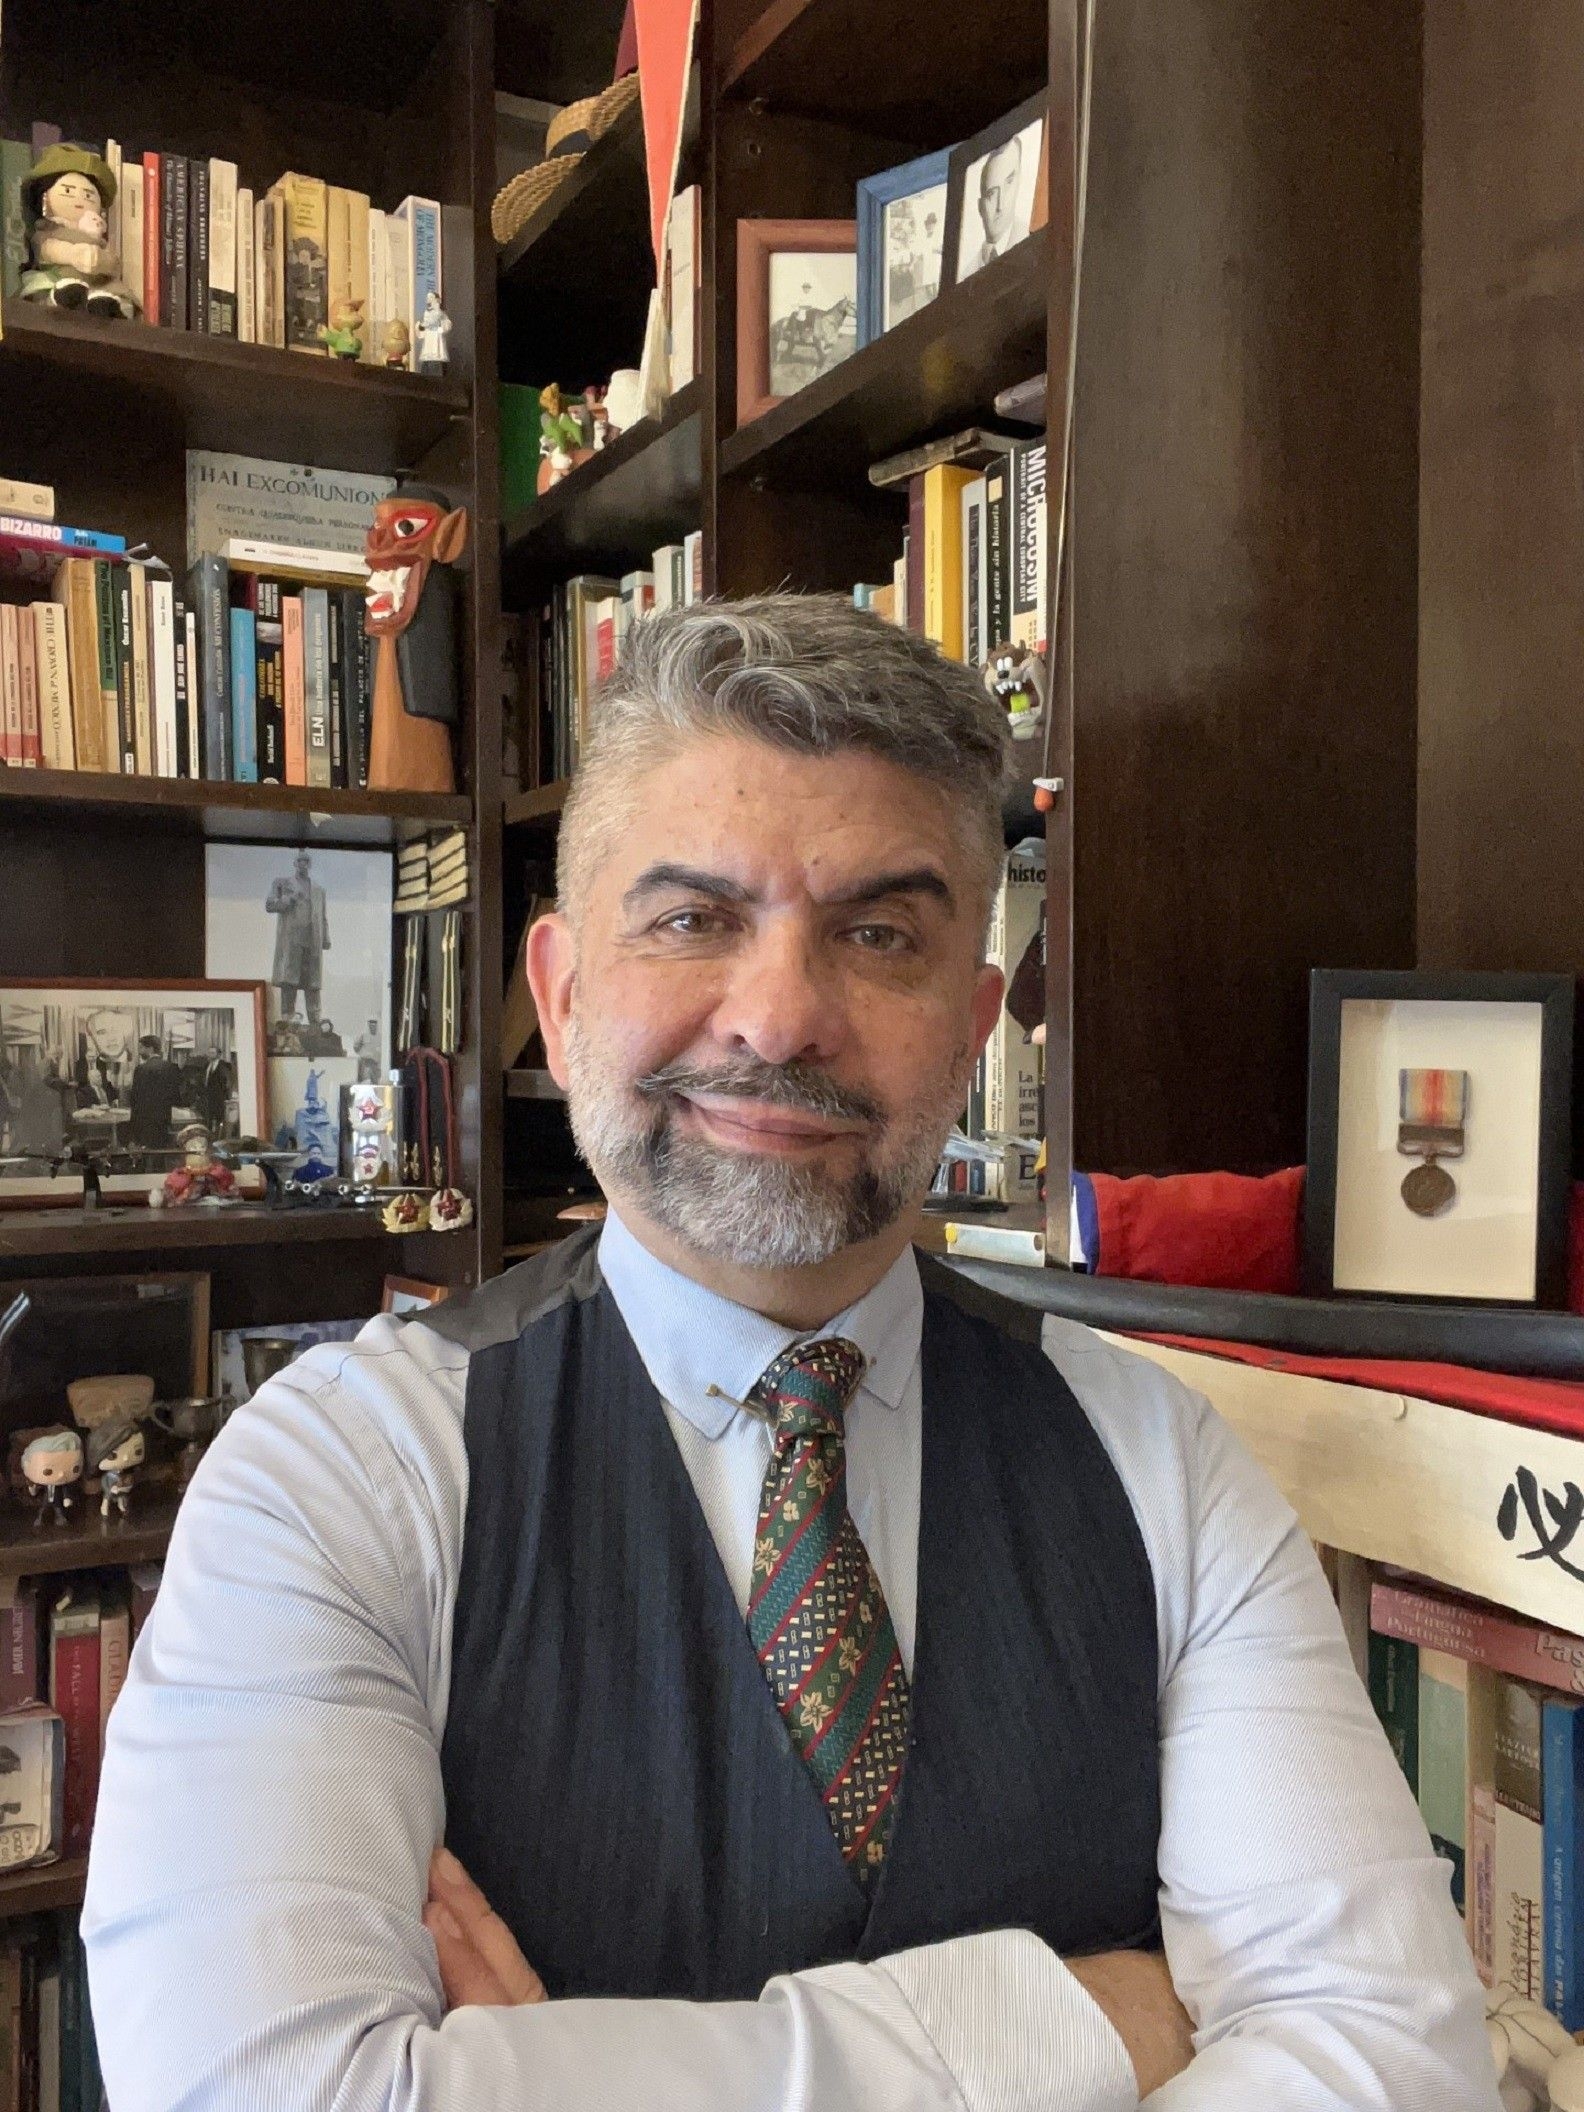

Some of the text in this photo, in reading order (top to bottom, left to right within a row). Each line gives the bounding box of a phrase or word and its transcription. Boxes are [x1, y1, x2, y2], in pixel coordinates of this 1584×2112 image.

[176, 164, 185, 221] AMERICAN
[200, 466, 238, 486] HAI
[0, 516, 62, 541] BIZARRO
[993, 571, 1001, 601] gente
[45, 615, 55, 634] THE
[47, 638, 57, 680] CROWN
[50, 690, 61, 730] MEXICO
[311, 717, 325, 747] ELN
[1008, 860, 1046, 883] histo
[1019, 1070, 1034, 1083] La
[1019, 1102, 1037, 1112] asc
[1537, 1632, 1584, 1669] Pas
[72, 1664, 81, 1695] FALL
